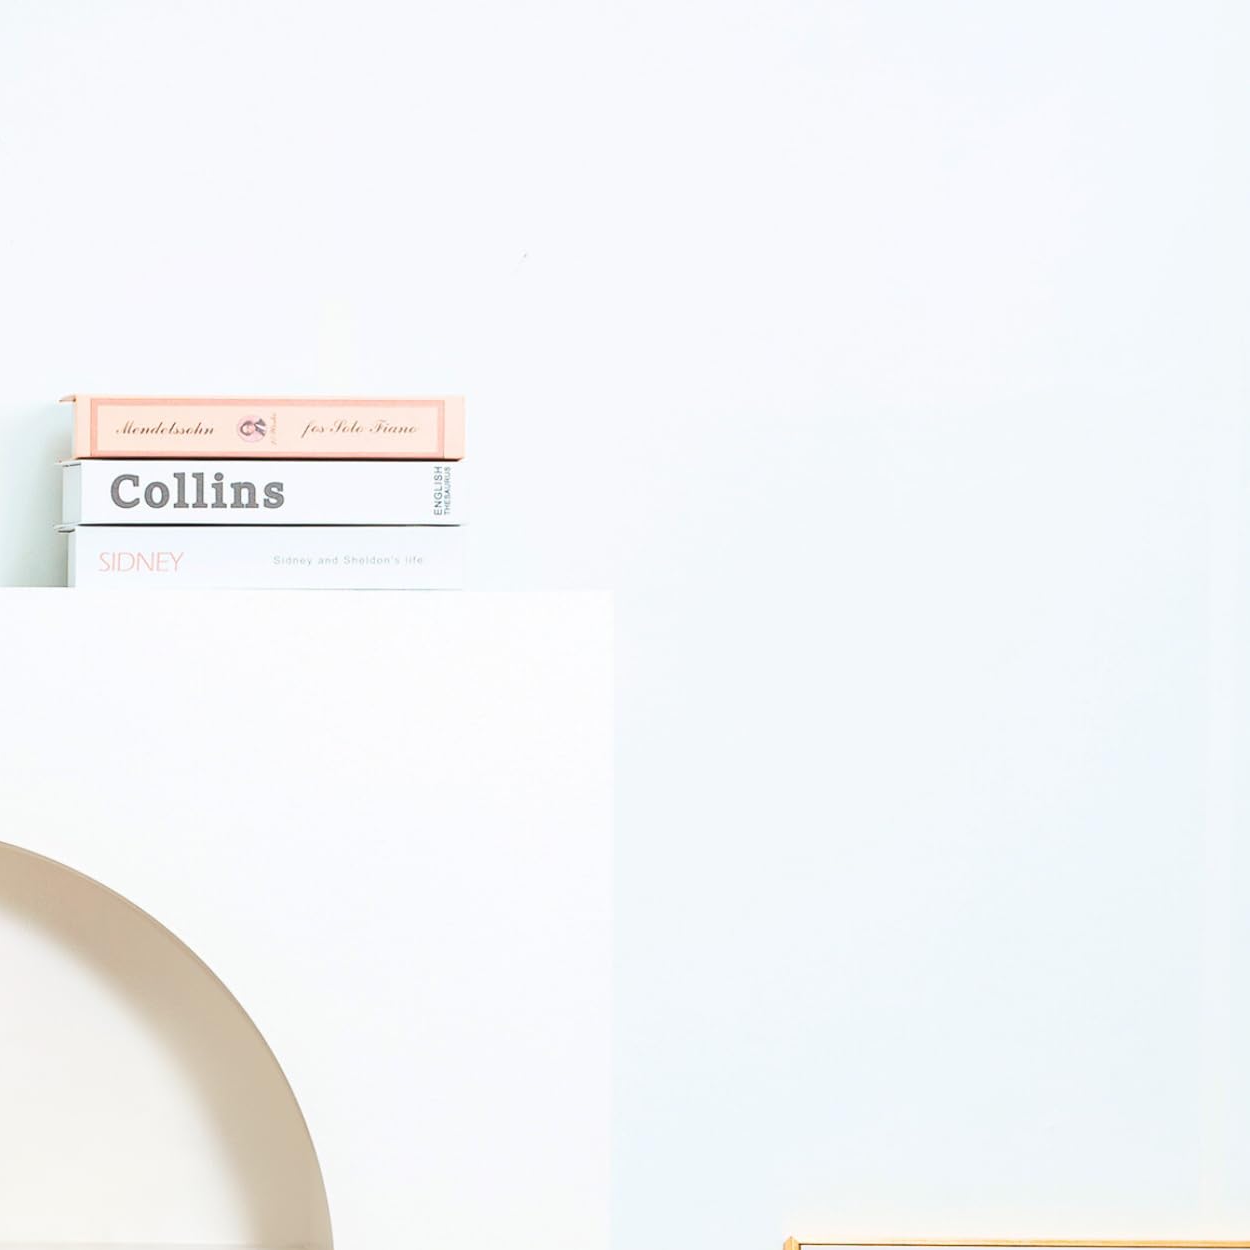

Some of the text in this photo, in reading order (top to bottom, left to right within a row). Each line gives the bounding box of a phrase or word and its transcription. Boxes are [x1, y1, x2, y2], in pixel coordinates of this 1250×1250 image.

[115, 419, 214, 435] Mendelssohn
[110, 472, 285, 509] Collins
[433, 466, 443, 516] ENGLISH
[443, 466, 451, 515] THESAURUS
[98, 551, 185, 573] SIDNEY
[273, 555, 312, 566] Sidney
[317, 555, 338, 565] and
[405, 555, 424, 565] life
